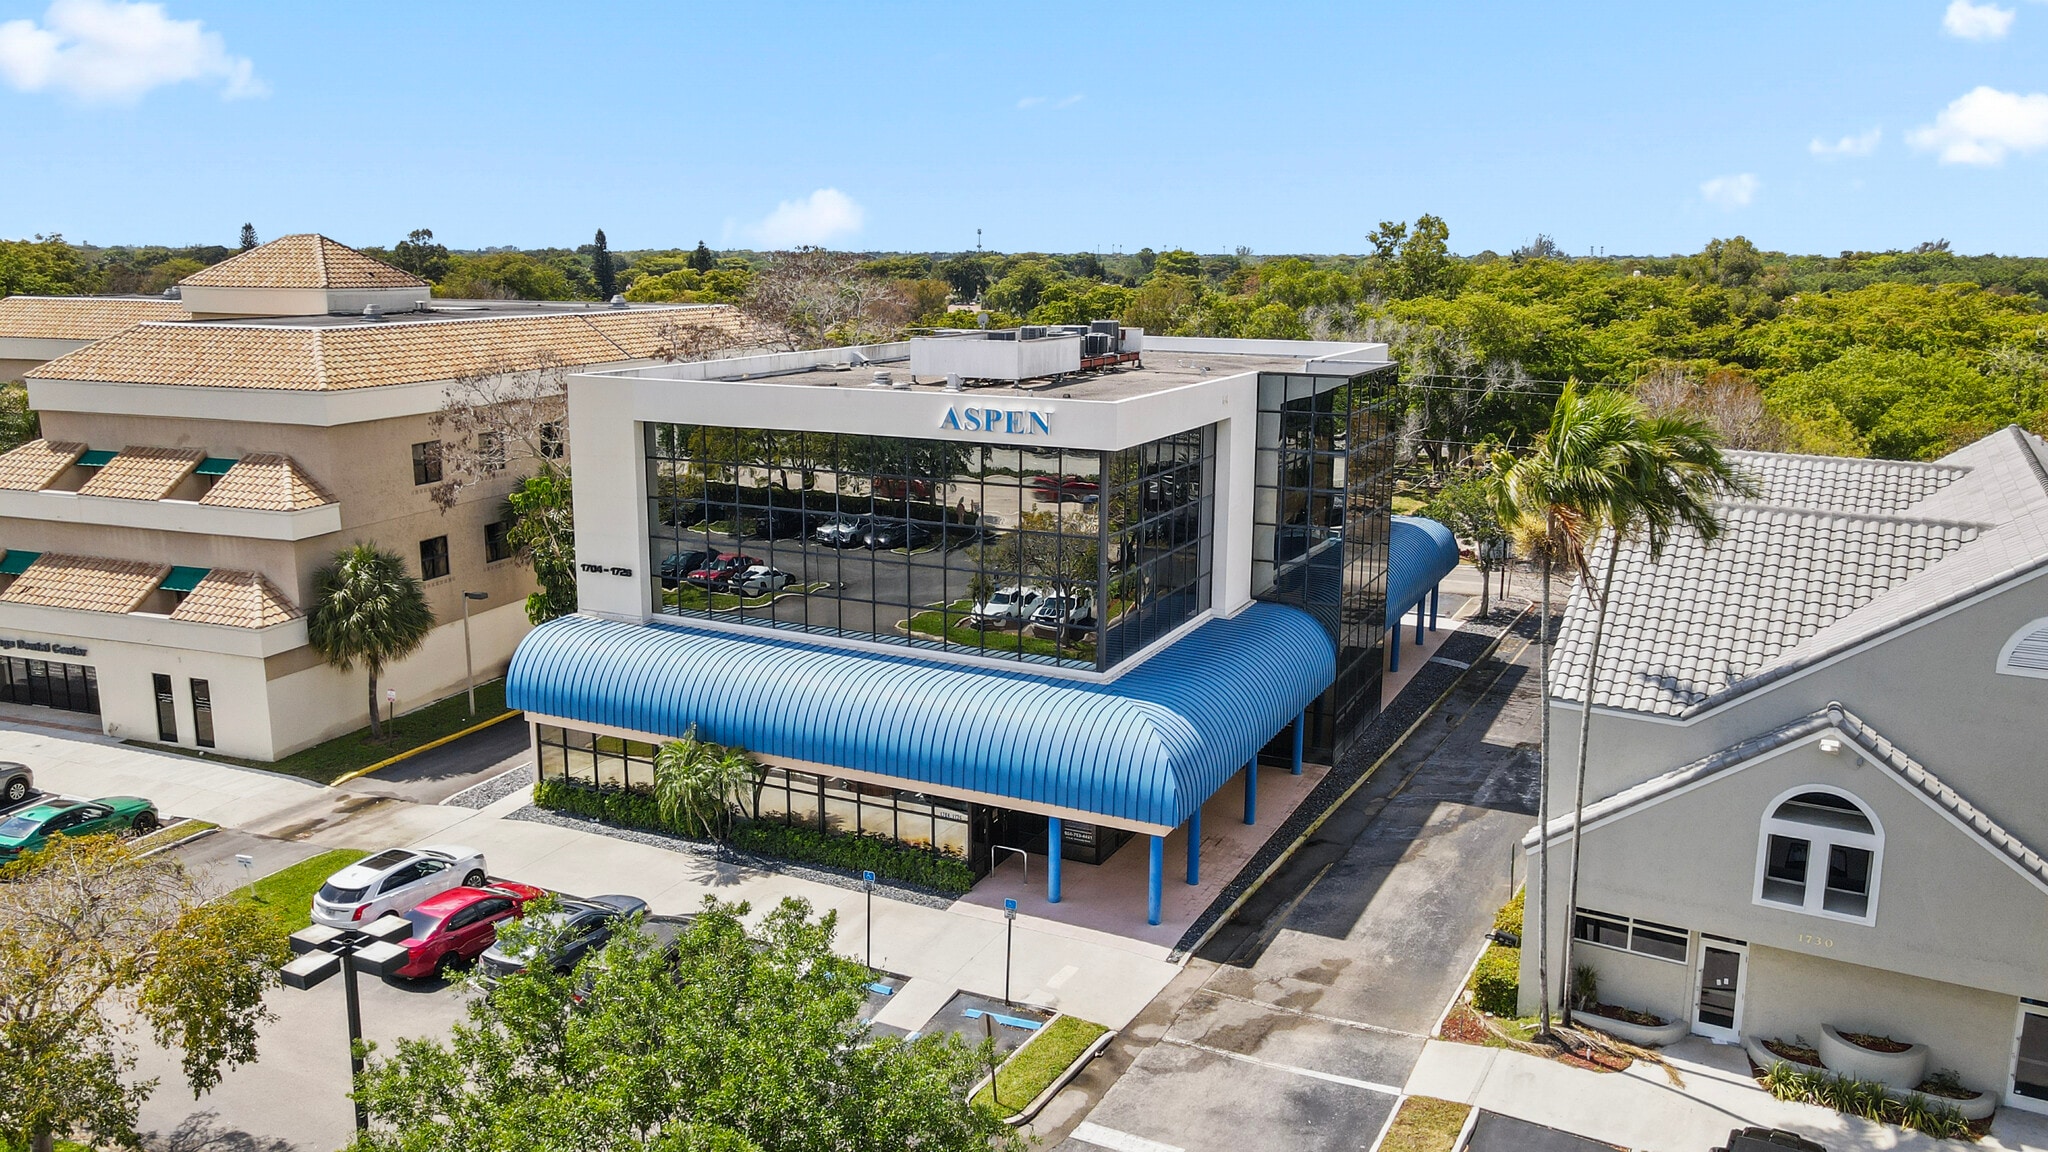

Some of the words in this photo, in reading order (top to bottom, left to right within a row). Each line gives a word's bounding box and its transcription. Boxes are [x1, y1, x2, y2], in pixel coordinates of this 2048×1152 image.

[939, 405, 1055, 436] ASPEN
[581, 563, 602, 574] 1704
[16, 639, 51, 653] Dental
[52, 643, 88, 657] Center
[1798, 934, 1833, 948] 1730
